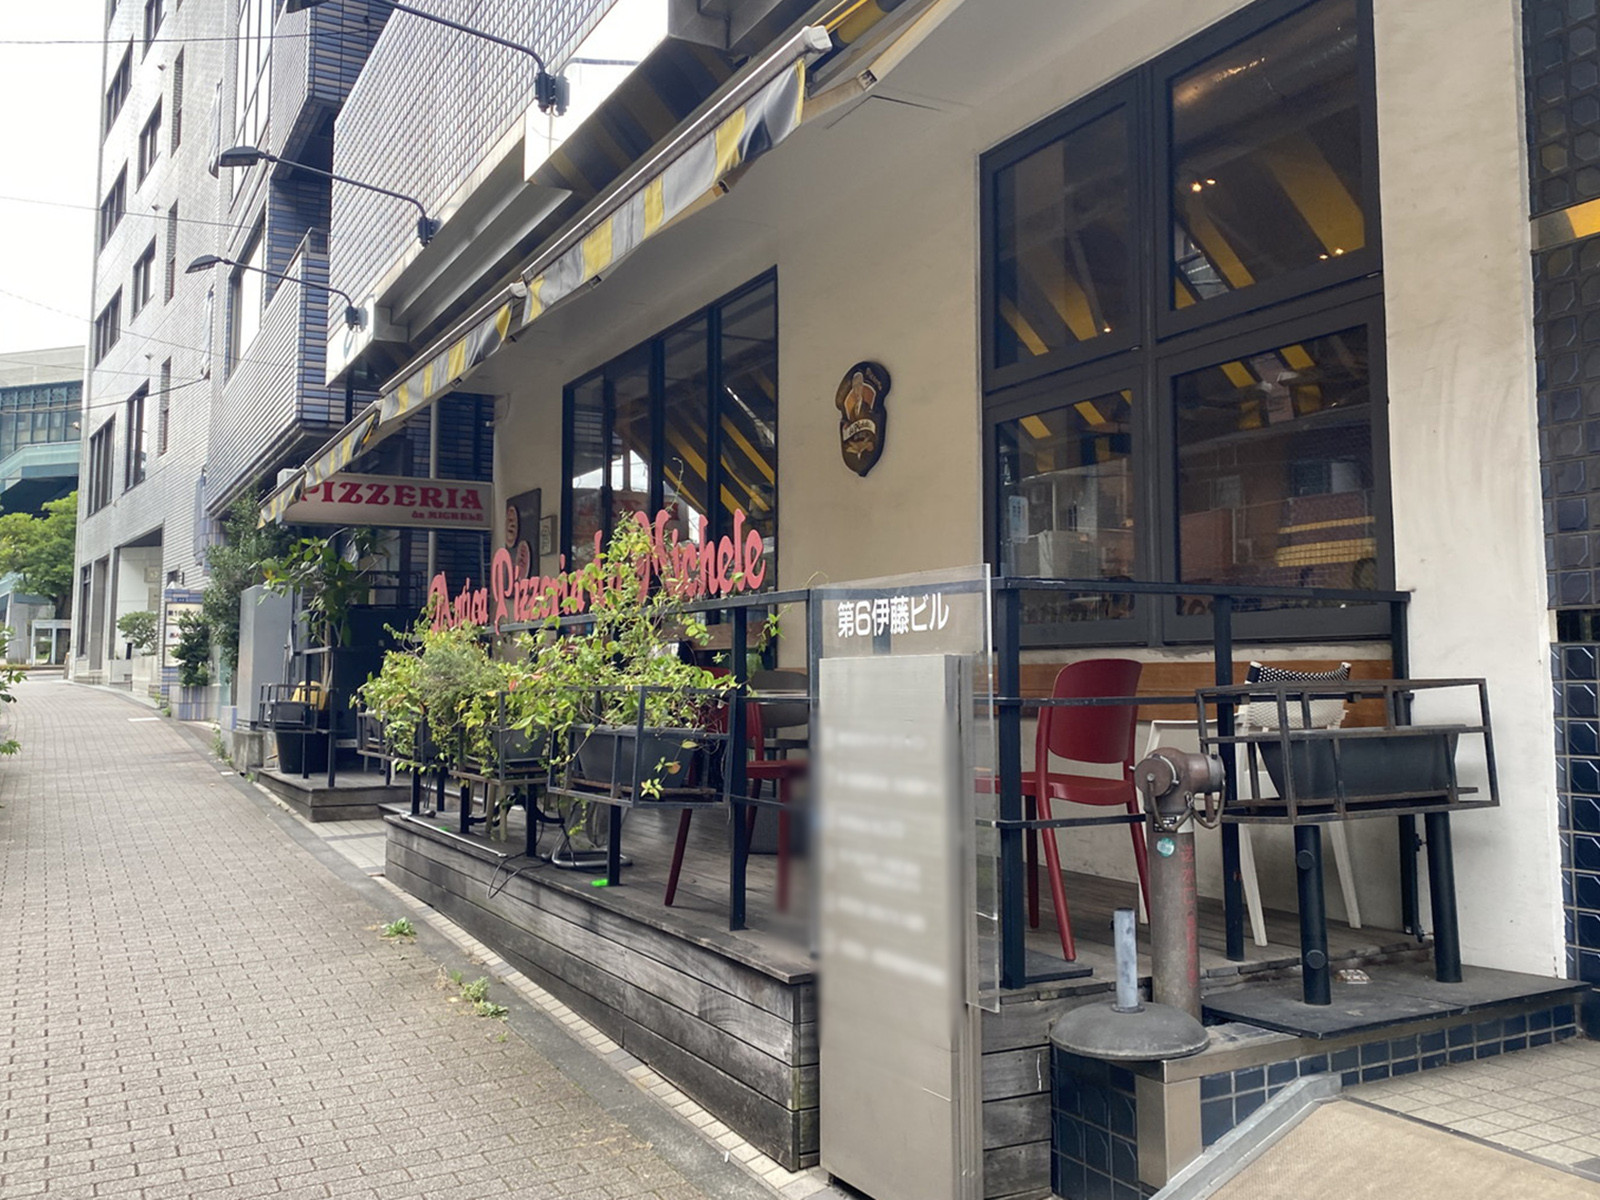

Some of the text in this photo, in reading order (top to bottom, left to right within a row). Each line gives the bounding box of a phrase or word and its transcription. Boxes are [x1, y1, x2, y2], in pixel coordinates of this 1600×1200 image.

[632, 508, 766, 604] Michele
[837, 592, 950, 638] 第6伊藤ビル
